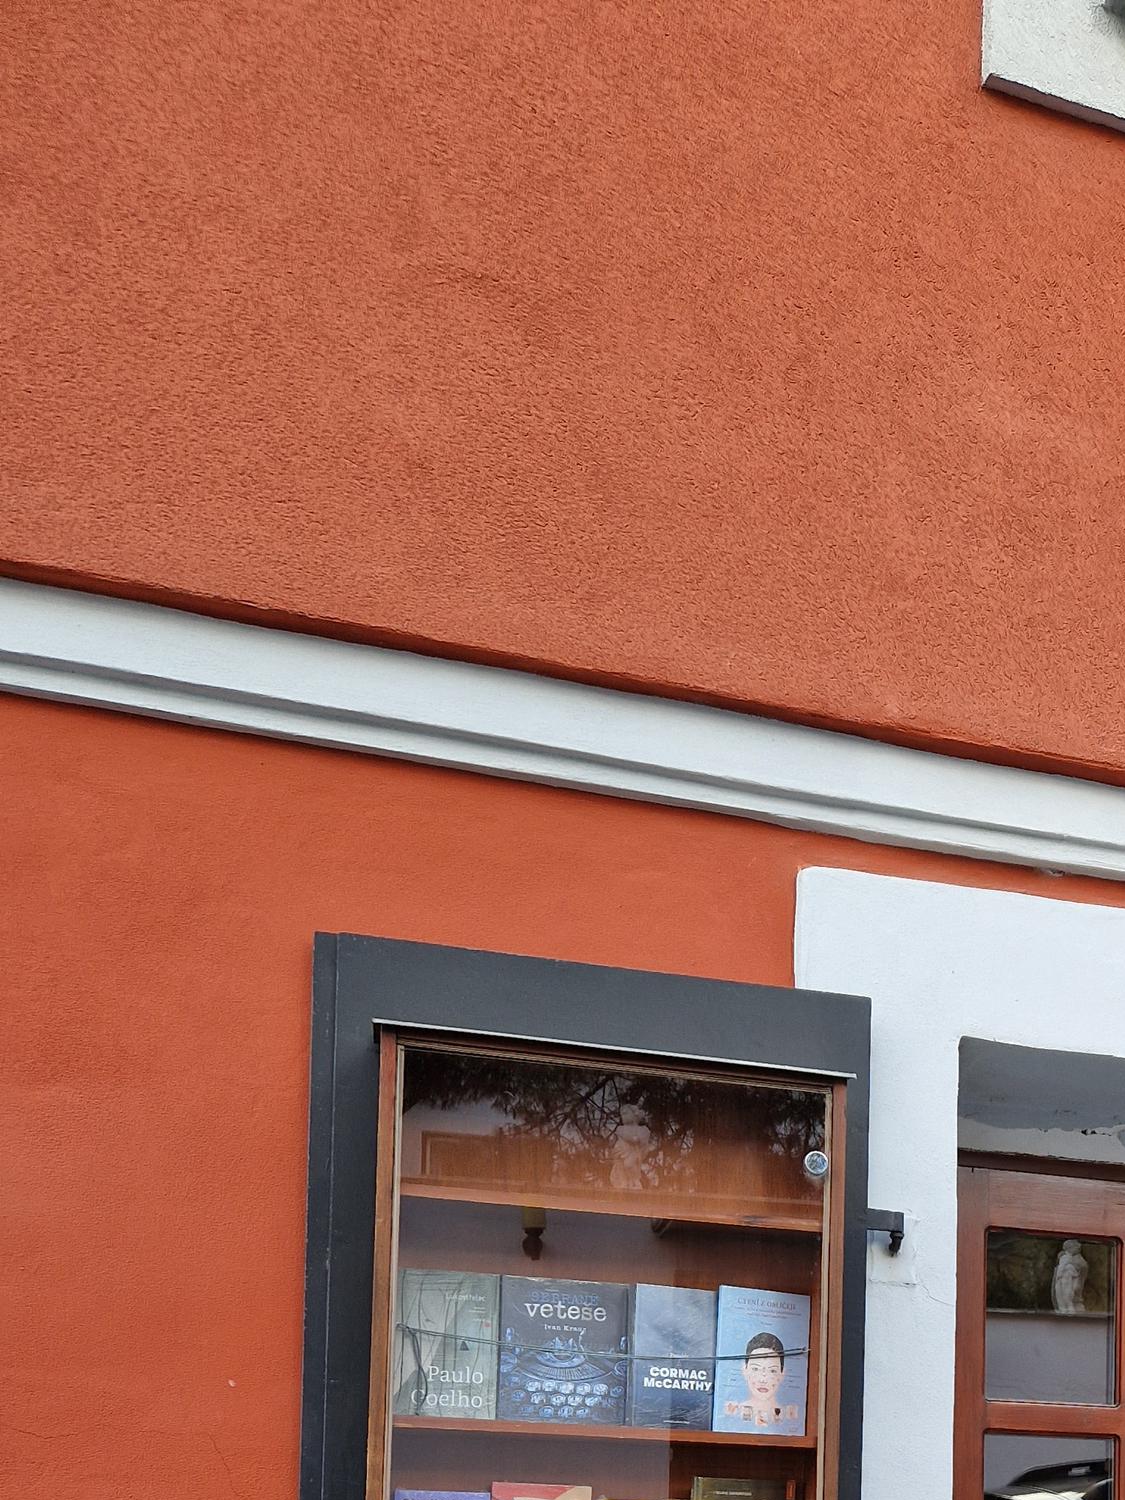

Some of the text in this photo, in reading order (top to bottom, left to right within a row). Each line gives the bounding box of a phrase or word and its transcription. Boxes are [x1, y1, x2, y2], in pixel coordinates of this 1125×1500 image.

[428, 1365, 484, 1384] Paulo
[650, 1366, 707, 1380] CORMAC
[643, 1377, 712, 1391] McCARTHY
[411, 1389, 482, 1408] Coelho
